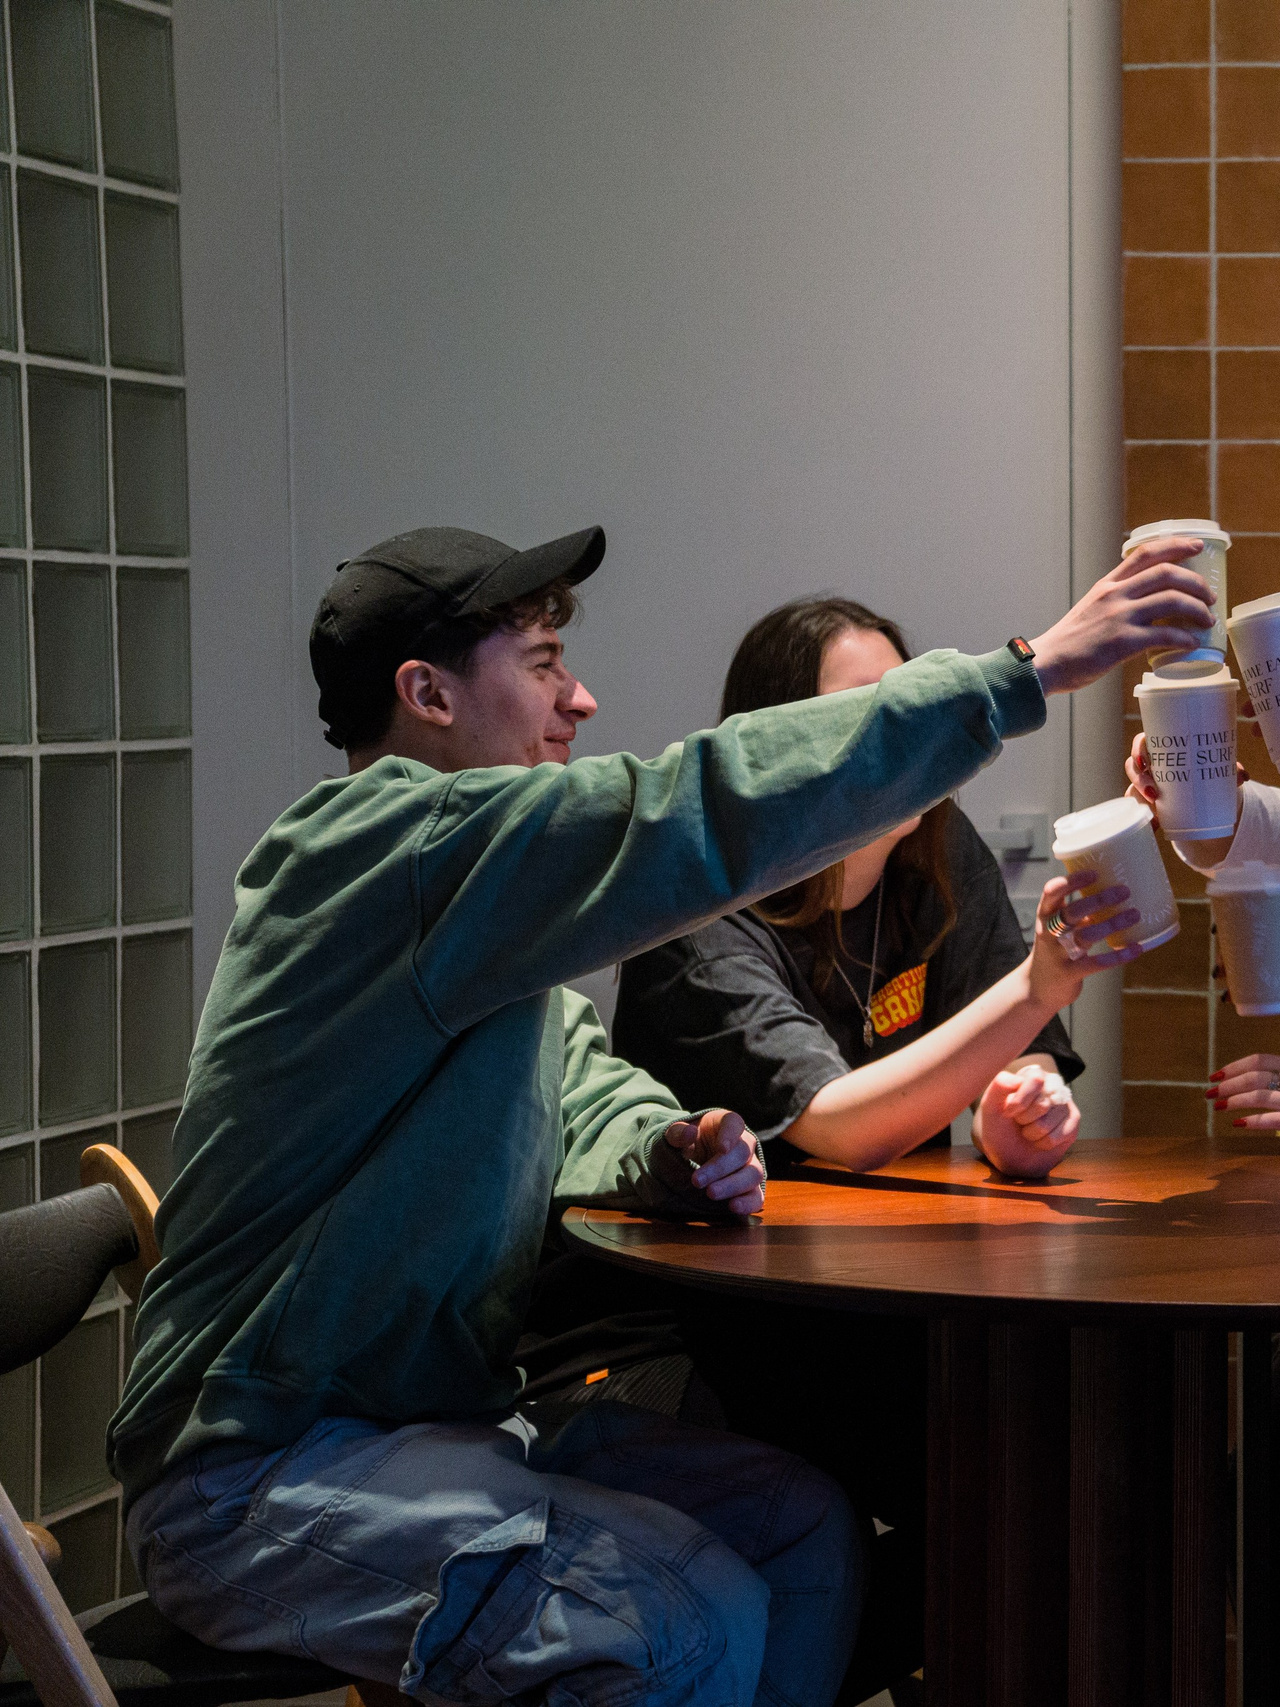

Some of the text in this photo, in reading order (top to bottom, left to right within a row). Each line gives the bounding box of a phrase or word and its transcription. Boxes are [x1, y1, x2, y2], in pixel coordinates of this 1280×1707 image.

[1150, 735, 1189, 748] SLOW
[1193, 731, 1228, 746] TIME
[1196, 746, 1234, 765] SURF
[1155, 770, 1191, 783] SLOW
[1197, 765, 1230, 780] TIME
